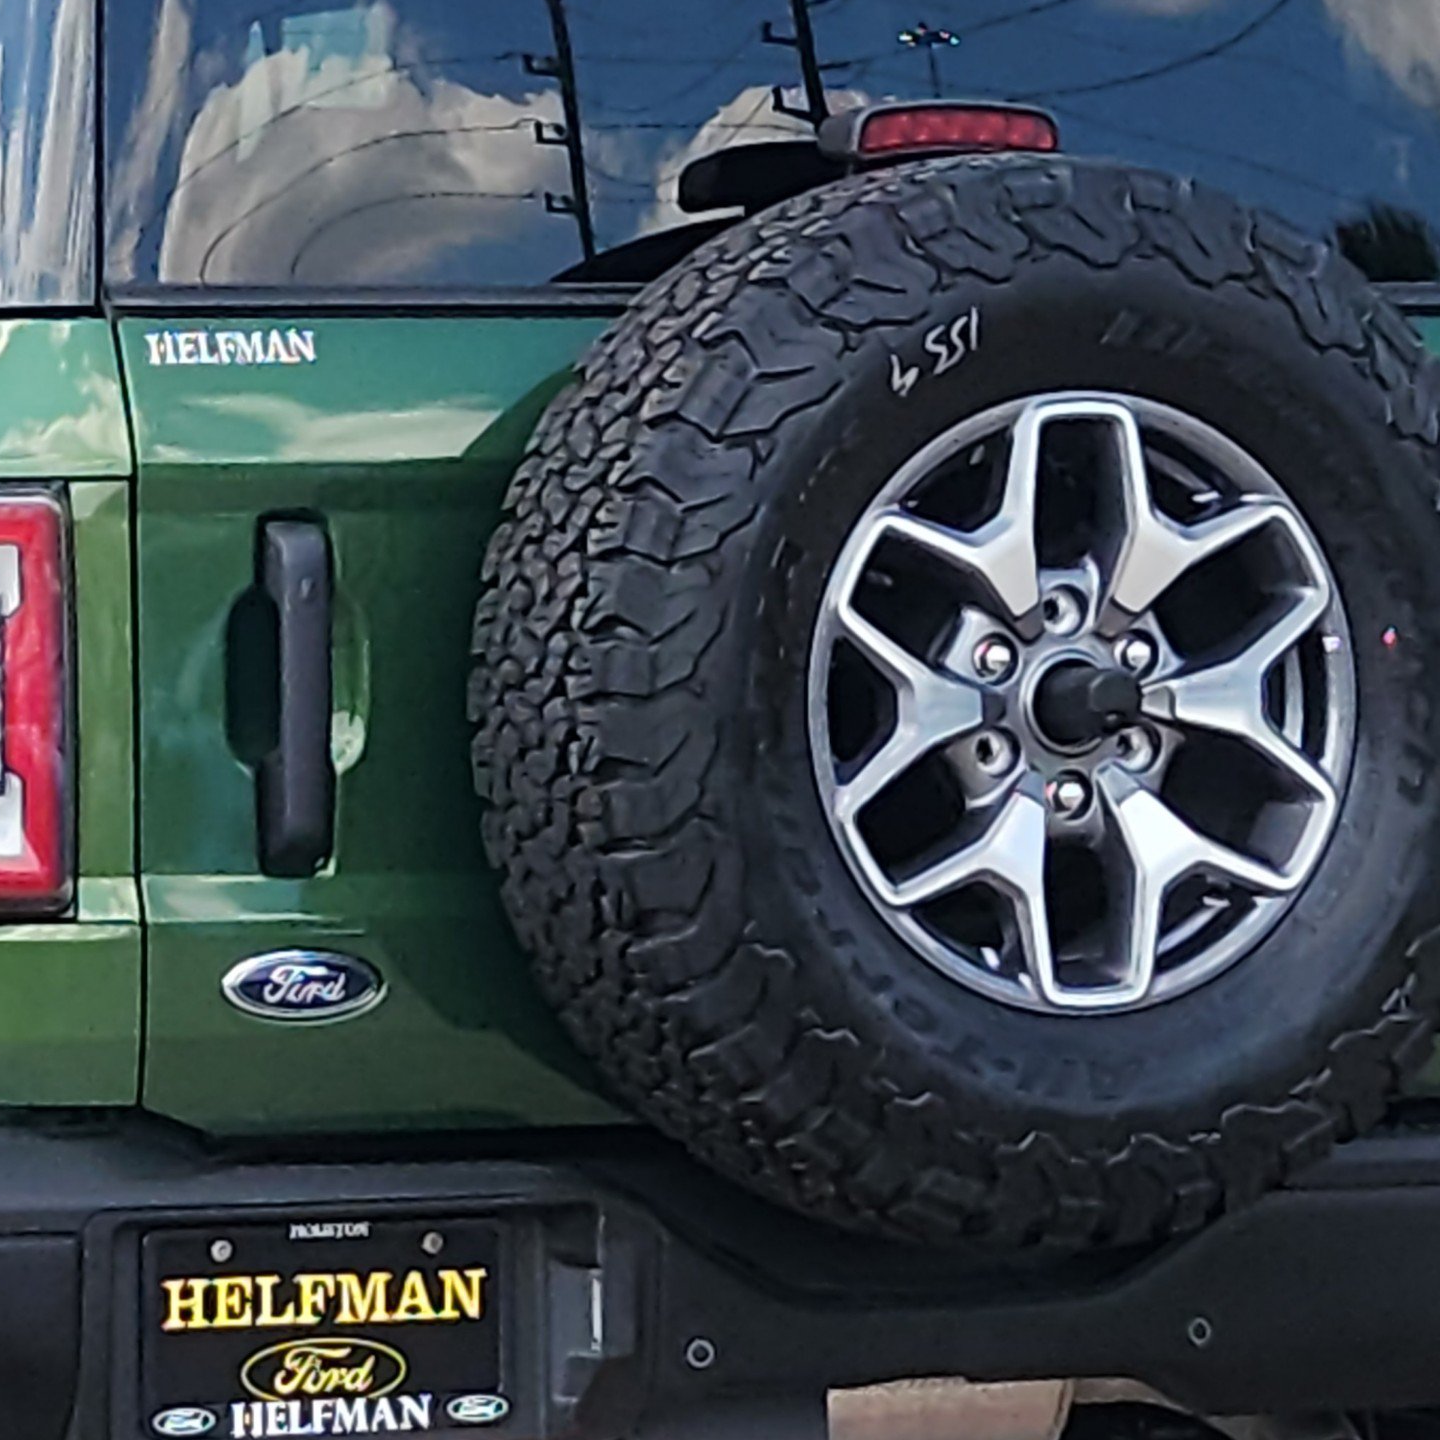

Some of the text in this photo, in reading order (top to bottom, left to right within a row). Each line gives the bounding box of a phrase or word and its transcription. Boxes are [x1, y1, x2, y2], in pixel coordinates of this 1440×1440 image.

[143, 328, 317, 365] HELFMAN
[263, 965, 346, 1003] Ford
[161, 1267, 487, 1331] HELFMAN
[274, 1347, 375, 1395] Ford
[230, 1393, 433, 1439] HELFMAN
